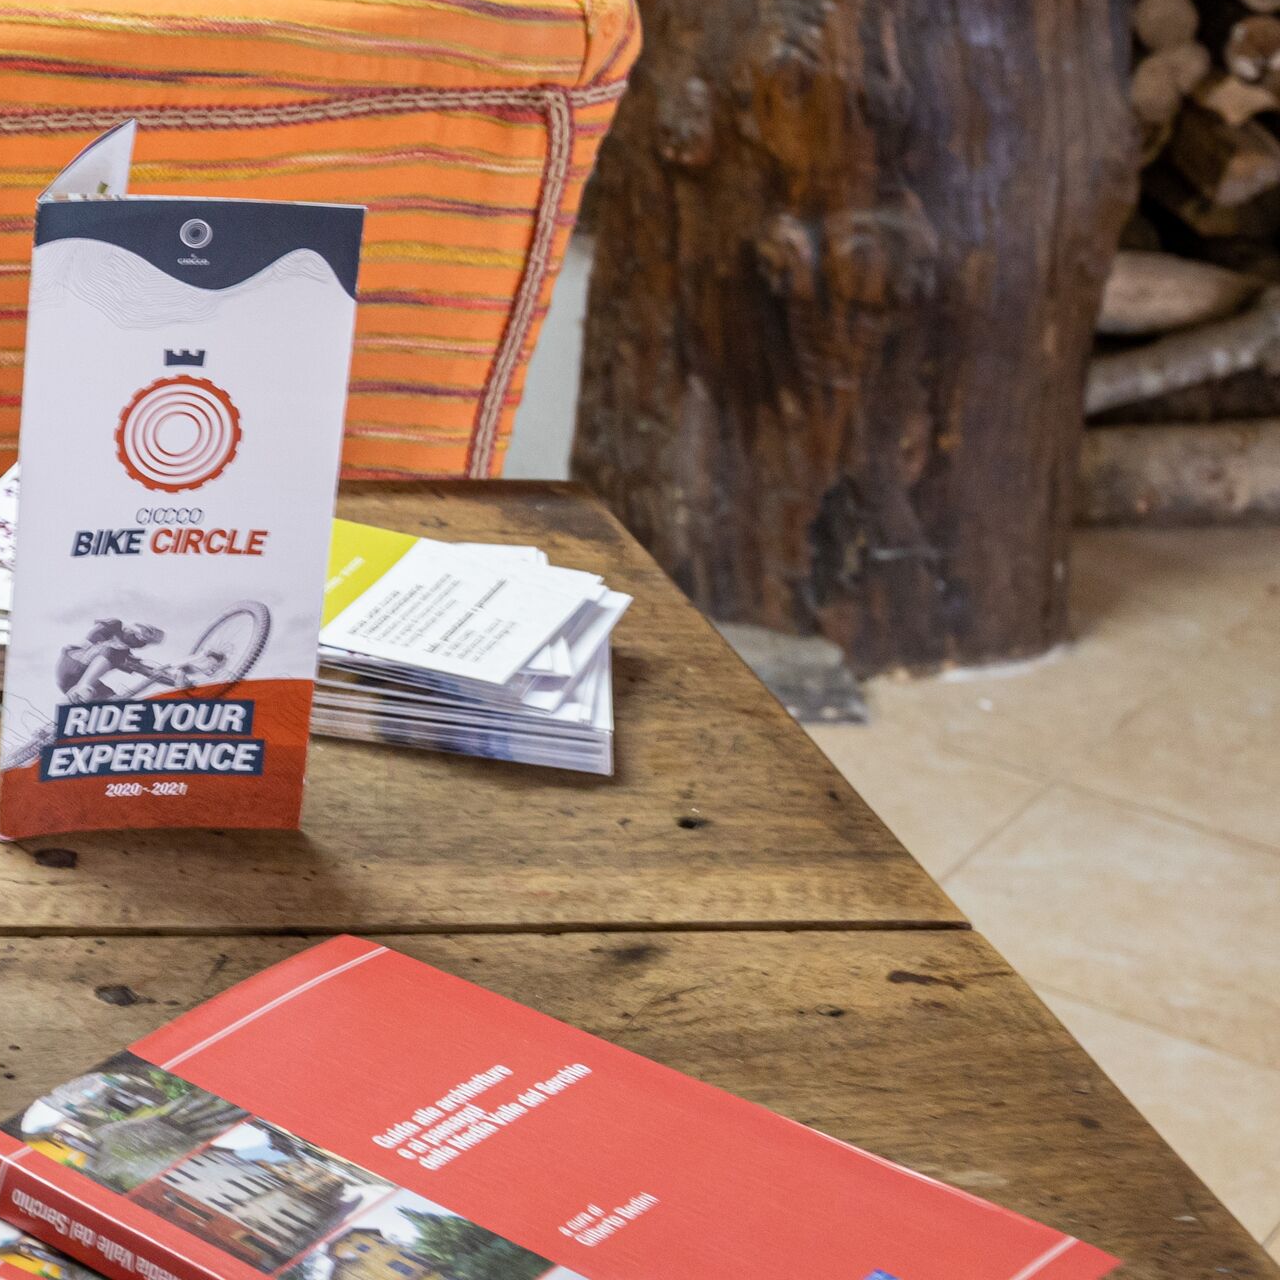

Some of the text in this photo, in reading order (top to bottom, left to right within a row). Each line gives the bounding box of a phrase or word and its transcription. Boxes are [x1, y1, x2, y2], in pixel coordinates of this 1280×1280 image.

[135, 507, 205, 526] CIOCCO
[70, 527, 270, 557] BIKE CIRCLE
[63, 702, 247, 737] RIDE YOUR
[47, 742, 261, 777] EXPERIENCE
[482, 1102, 528, 1126] Valle
[517, 1088, 548, 1108] del
[534, 1063, 593, 1096] Serchio
[371, 1120, 423, 1149] Guida
[11, 1188, 70, 1235] Serchio
[68, 1219, 98, 1248] del
[96, 1234, 136, 1272] Valle
